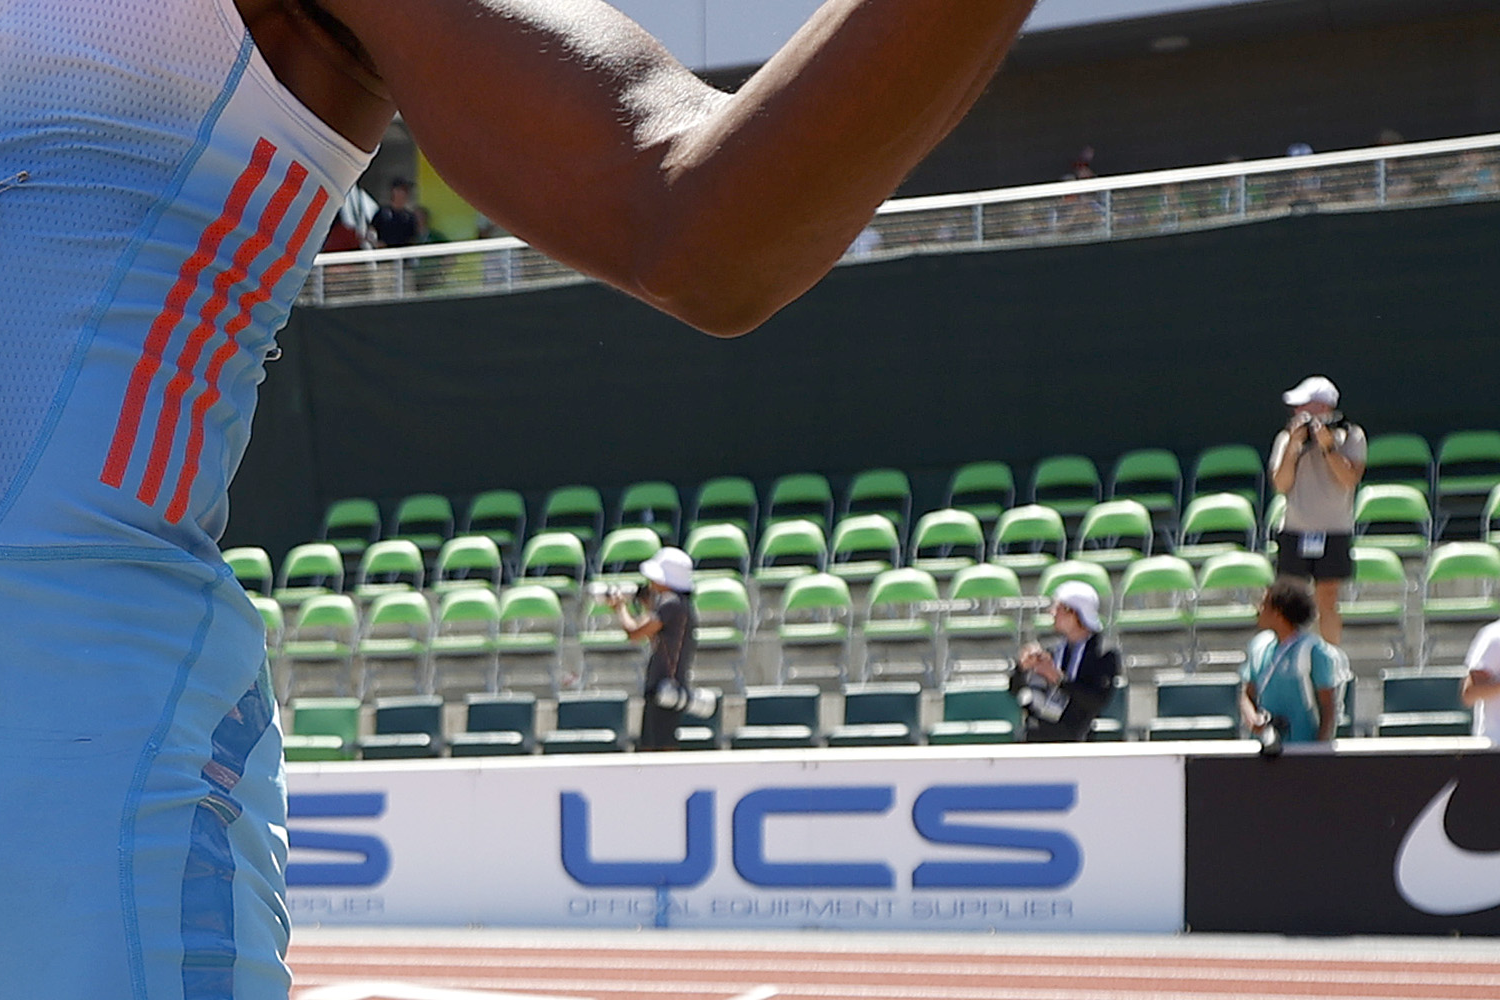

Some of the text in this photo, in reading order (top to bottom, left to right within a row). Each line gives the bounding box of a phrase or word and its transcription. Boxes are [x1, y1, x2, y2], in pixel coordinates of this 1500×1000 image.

[560, 783, 1085, 890] UCS
[568, 897, 1075, 918] OFFICAL EQUIPMENT SUPPLIER
